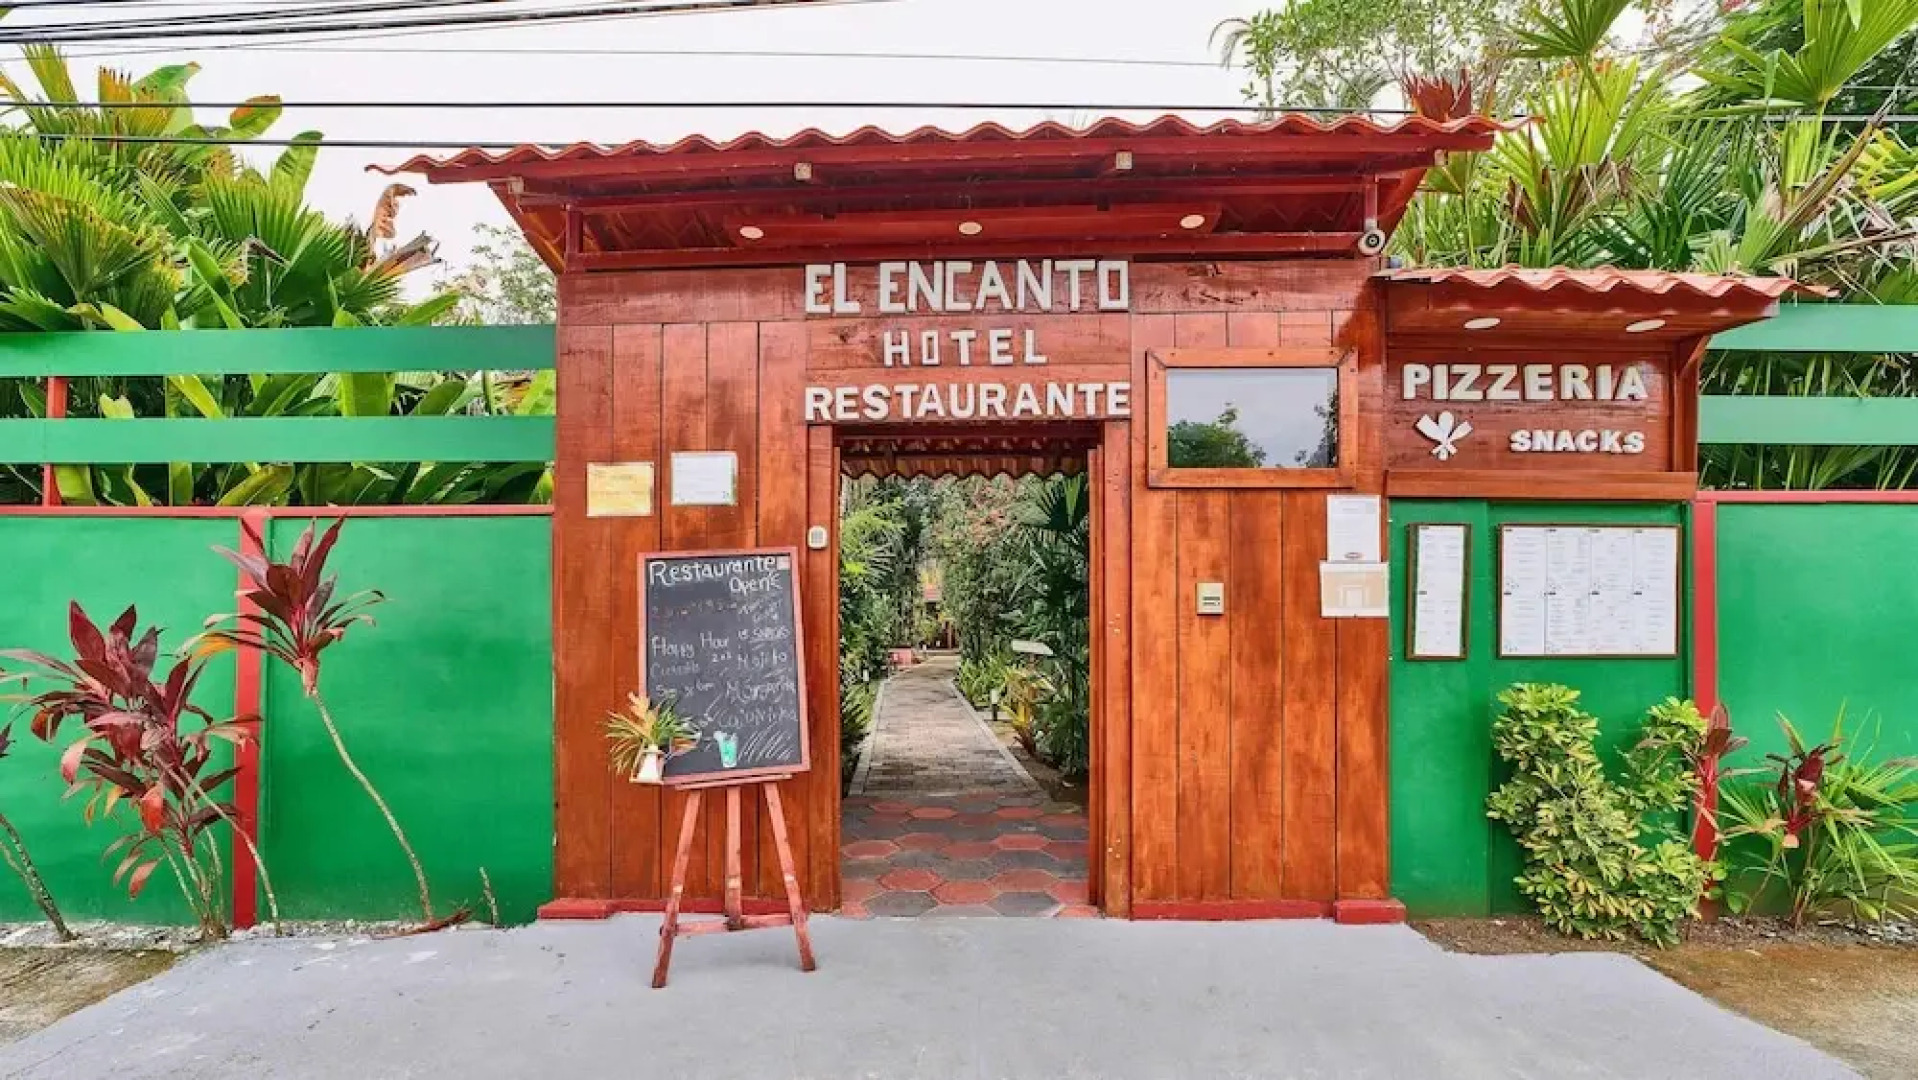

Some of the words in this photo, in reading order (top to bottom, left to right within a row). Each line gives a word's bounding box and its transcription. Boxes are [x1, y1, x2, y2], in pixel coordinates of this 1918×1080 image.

[805, 262, 861, 314] EL
[879, 259, 1129, 313] ENCANTO
[882, 329, 1048, 366] HOTEL
[1402, 363, 1649, 400] PIZZERIA
[805, 382, 1131, 421] RESTAURANTE
[1509, 429, 1645, 453] SNACKS
[649, 555, 776, 587] Restaurante
[729, 575, 771, 596] Open
[651, 635, 695, 659] Happy
[700, 631, 730, 649] Hour
